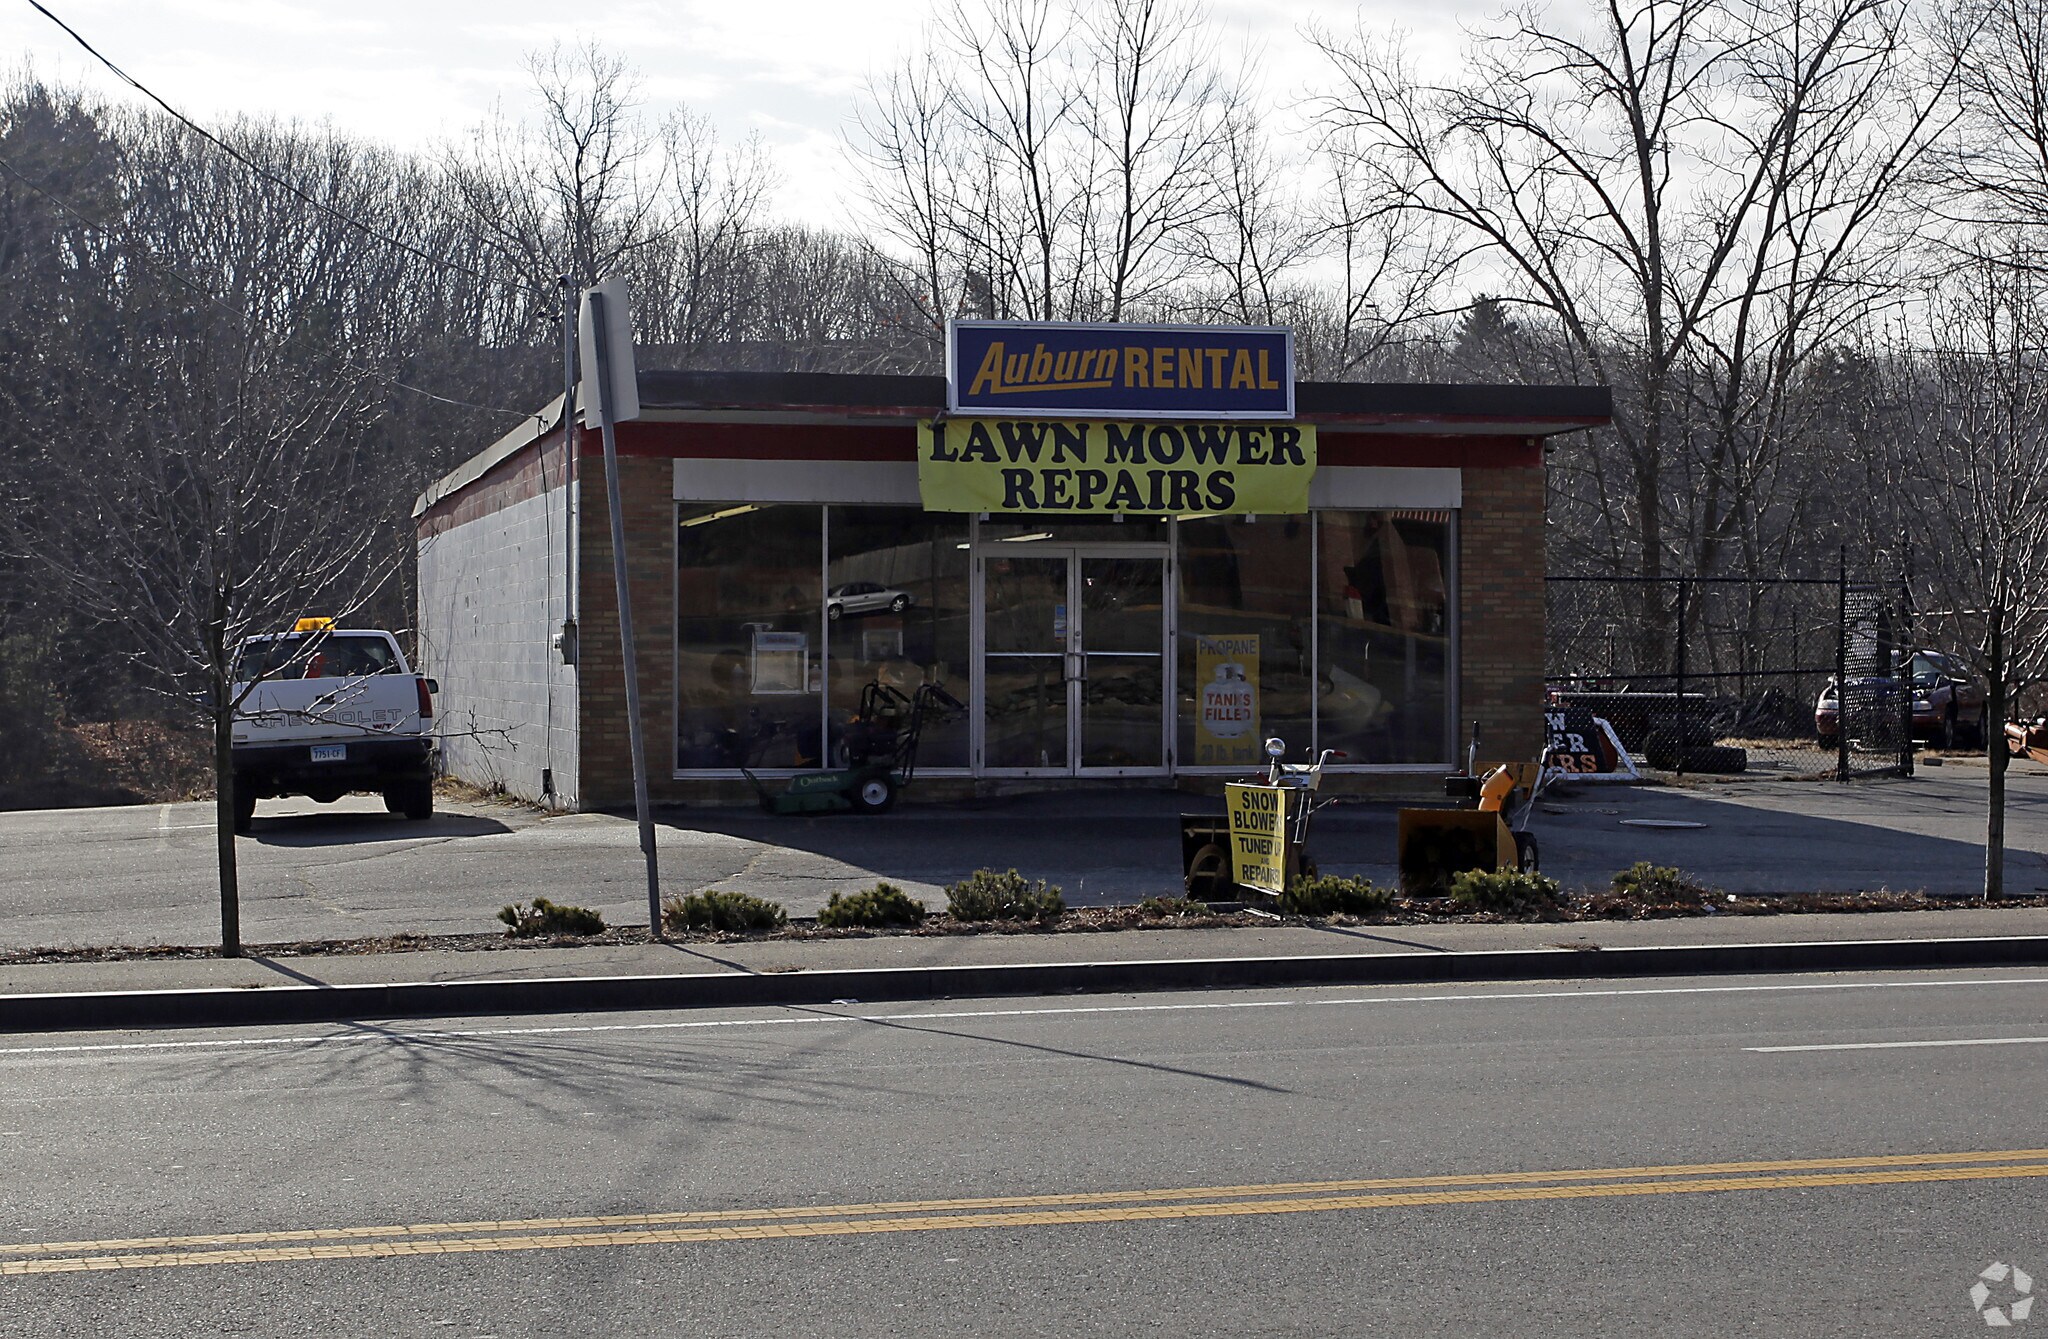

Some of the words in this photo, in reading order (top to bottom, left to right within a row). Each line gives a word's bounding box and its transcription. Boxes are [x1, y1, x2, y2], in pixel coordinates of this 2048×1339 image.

[968, 341, 1119, 395] Auburn
[1123, 346, 1279, 390] RENTAL
[929, 421, 1090, 464] LAWN
[1103, 423, 1306, 467] MOWER
[1000, 467, 1236, 511] REPAIRS
[1199, 639, 1257, 656] PROPANE
[251, 708, 402, 729] CHEVROLET
[1242, 791, 1279, 811] SNOW
[1239, 837, 1273, 855] TUNED
